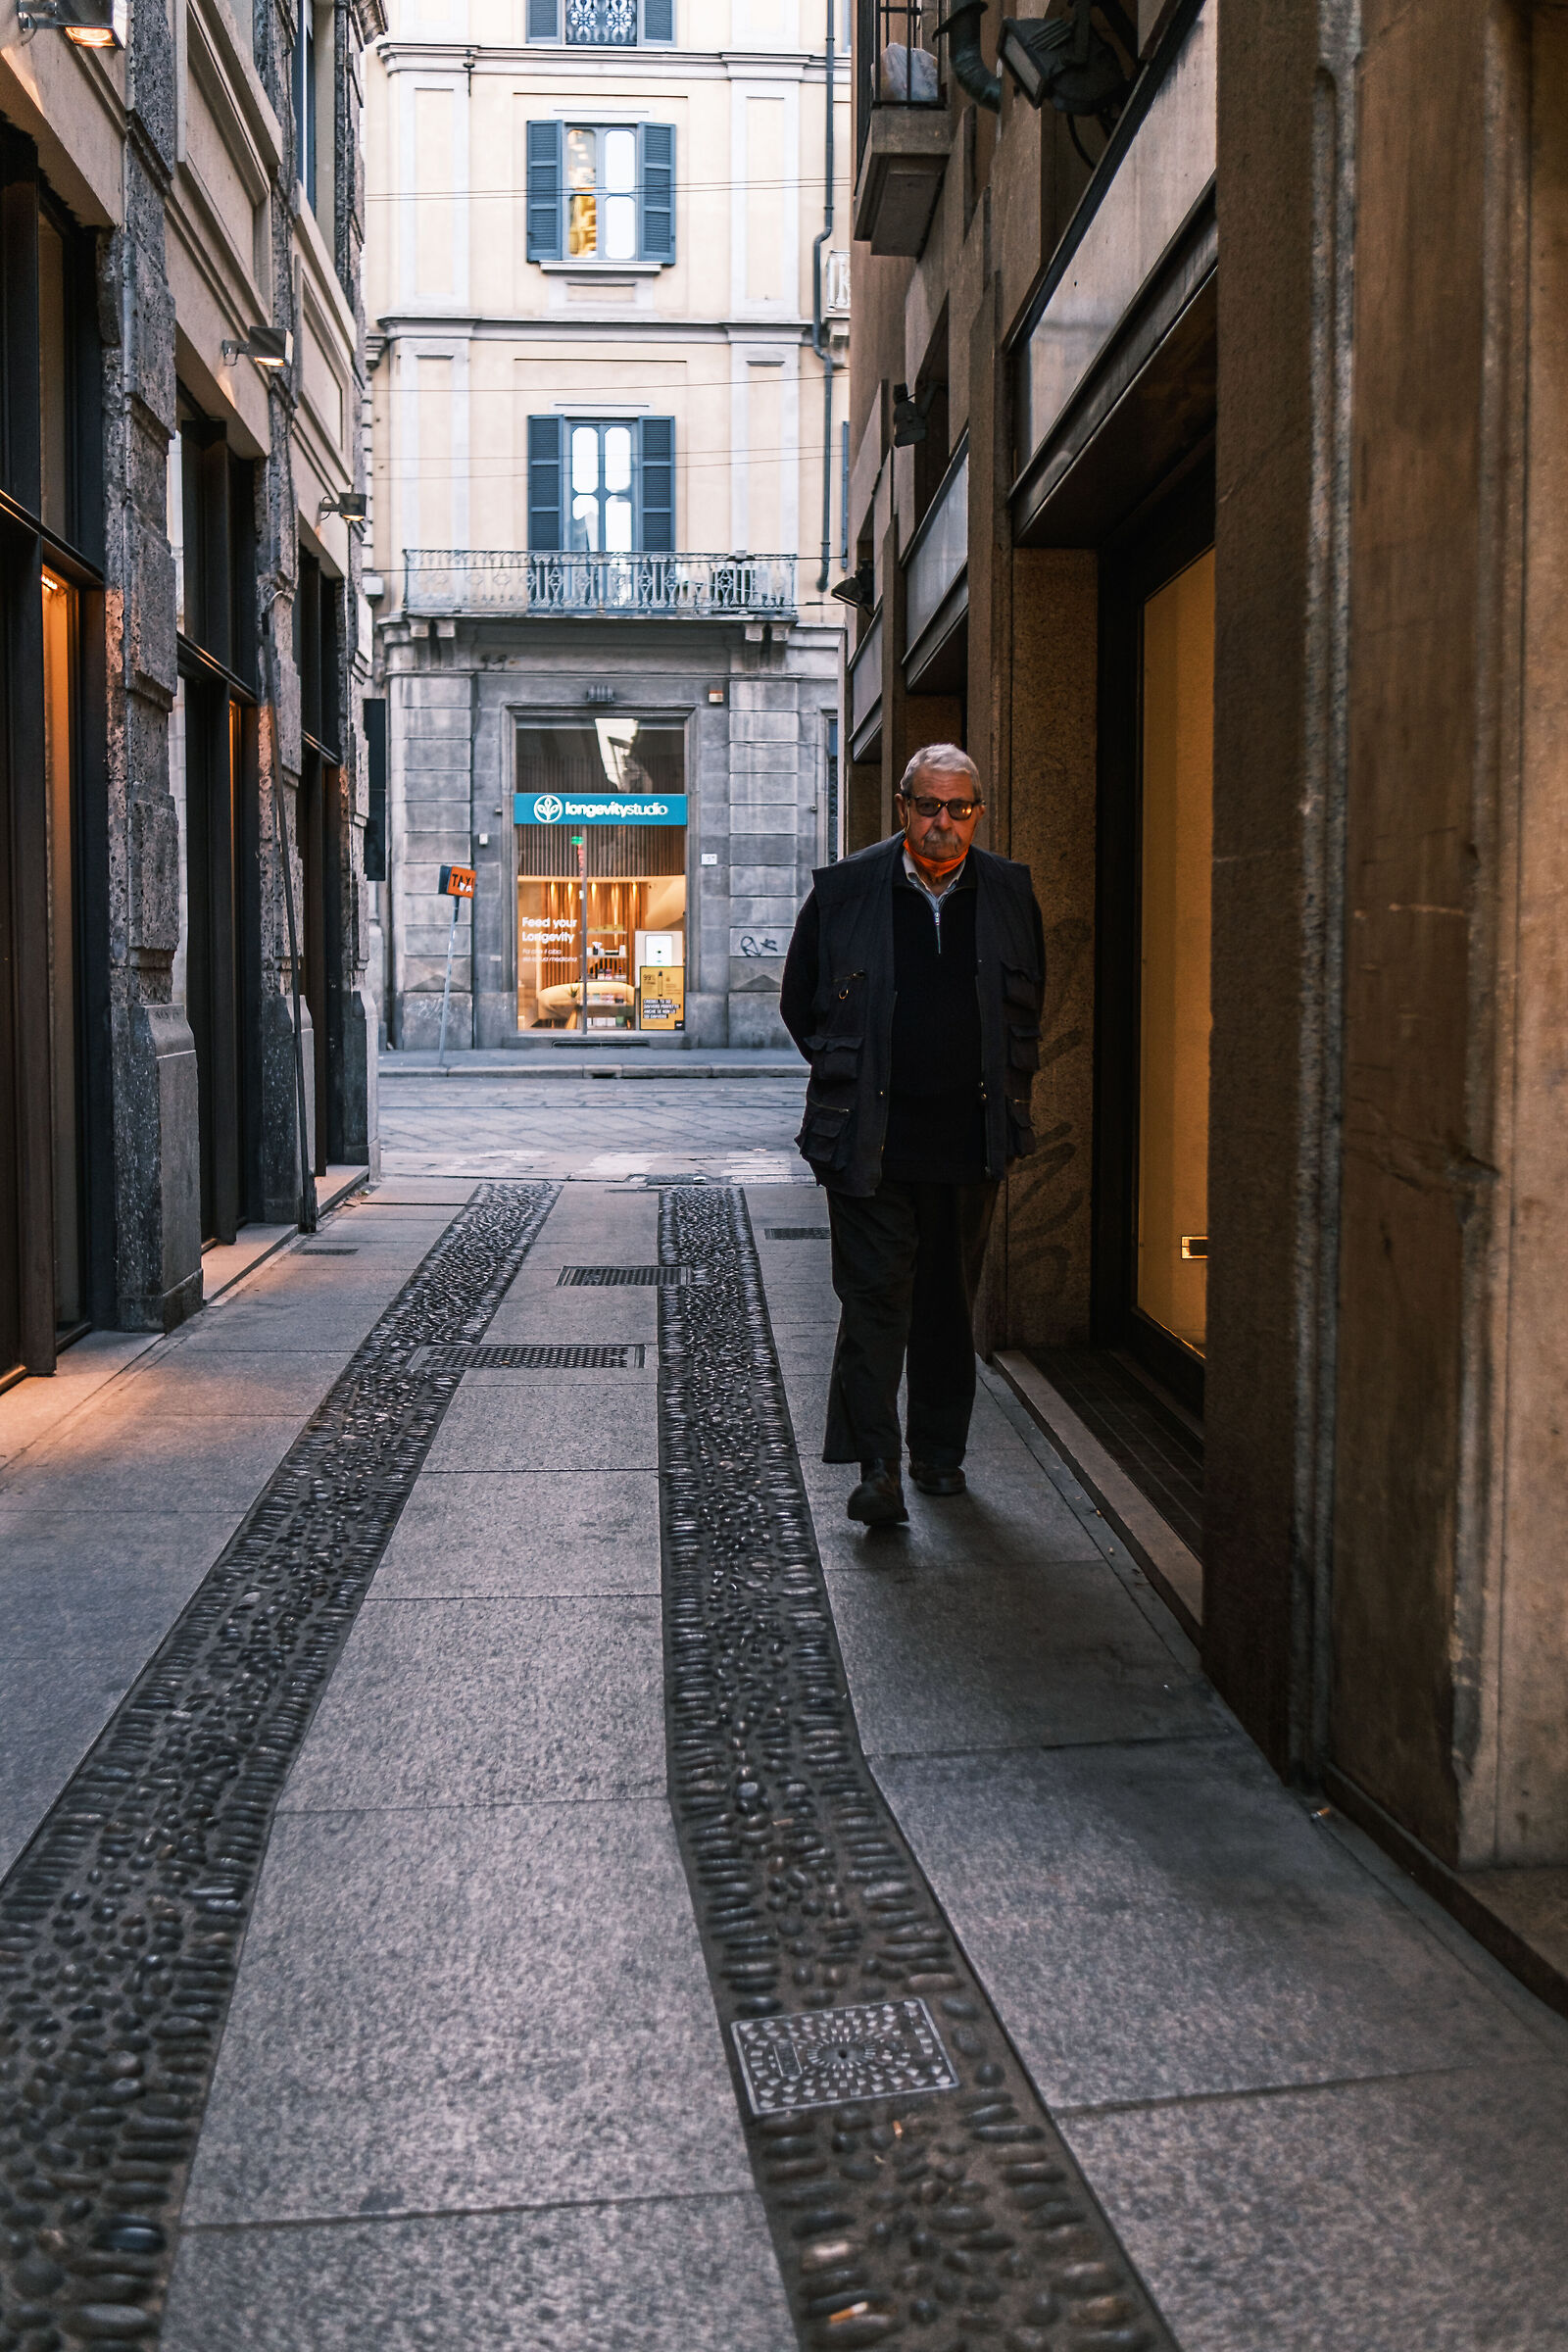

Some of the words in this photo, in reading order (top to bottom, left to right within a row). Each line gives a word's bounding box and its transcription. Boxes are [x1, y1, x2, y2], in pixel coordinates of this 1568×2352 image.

[565, 801, 668, 818] longevitystudio
[452, 873, 474, 890] TAXI
[522, 916, 550, 927] Feed
[553, 918, 577, 929] your
[522, 931, 574, 944] Longevity
